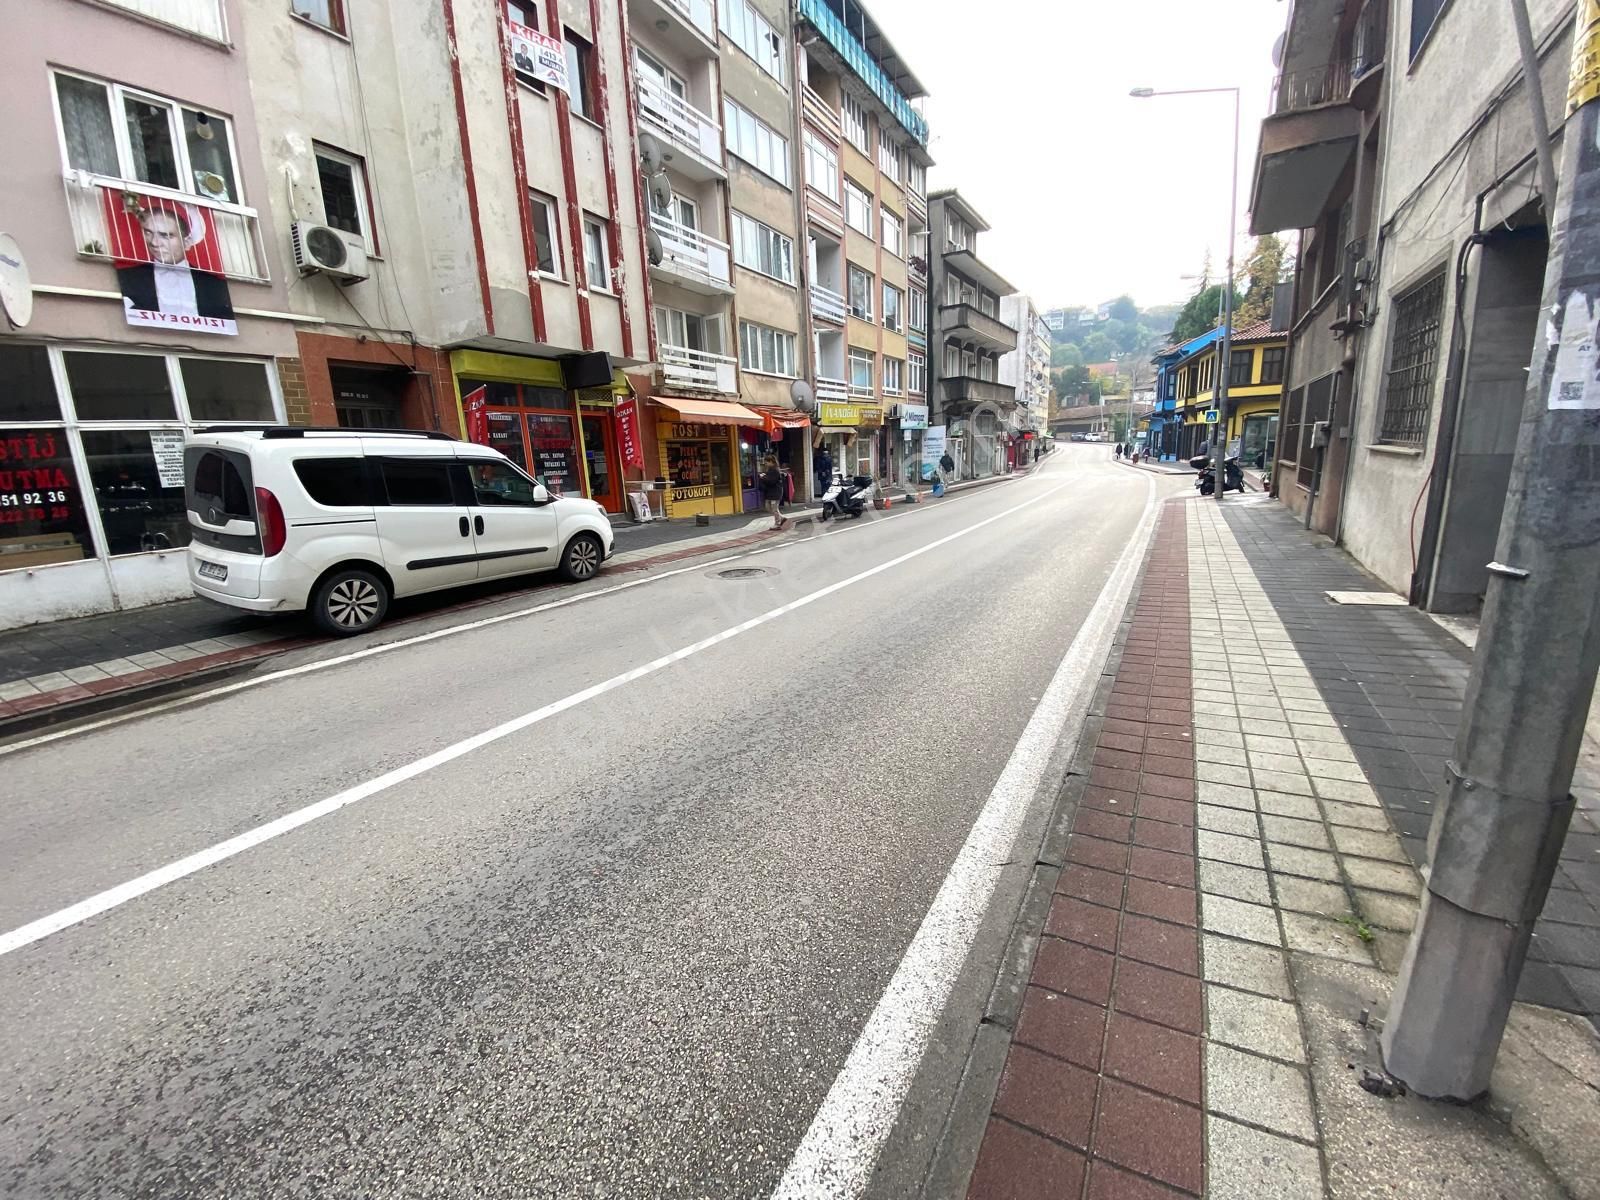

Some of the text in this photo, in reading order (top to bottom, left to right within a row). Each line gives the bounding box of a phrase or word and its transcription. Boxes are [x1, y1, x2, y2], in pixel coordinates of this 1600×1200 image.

[672, 424, 699, 437] TOST
[0, 490, 66, 507] 51 92 36
